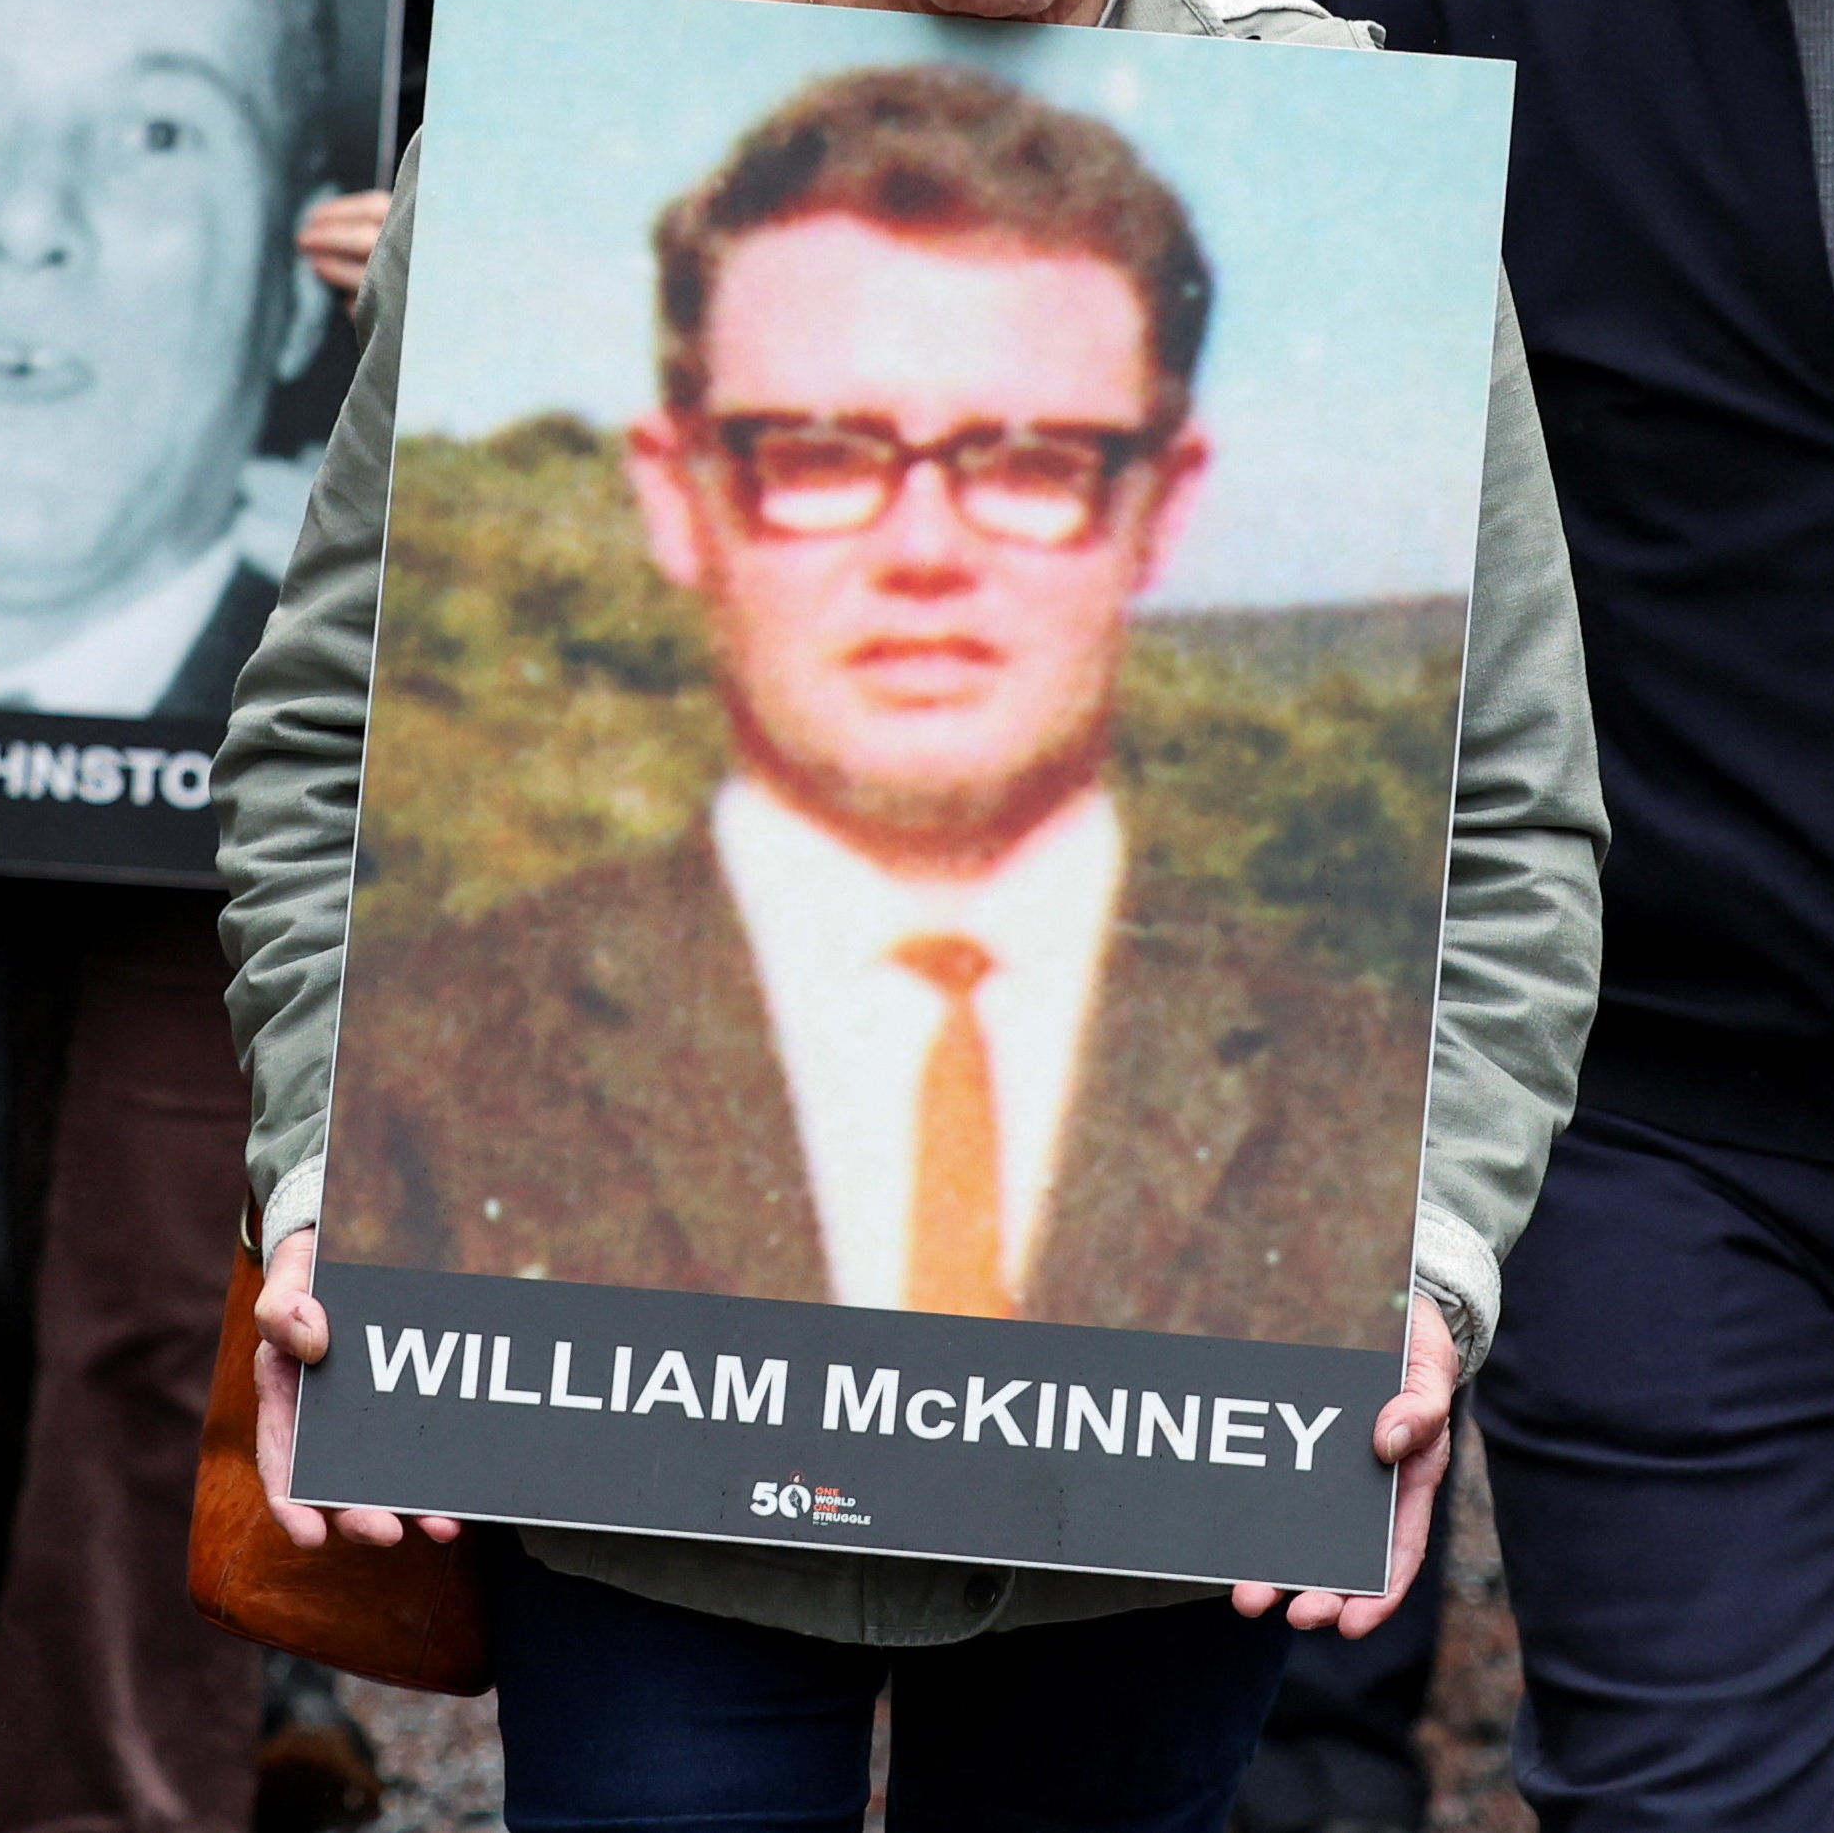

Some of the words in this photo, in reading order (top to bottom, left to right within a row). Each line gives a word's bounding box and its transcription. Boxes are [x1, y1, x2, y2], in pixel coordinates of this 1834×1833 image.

[365, 1324, 789, 1426] WILLIAM
[822, 1364, 1343, 1471] McKINNEY
[814, 1486, 840, 1497] ONE
[749, 1481, 811, 1519] 50
[814, 1494, 856, 1508] WORLD
[813, 1504, 839, 1514] ONE
[812, 1511, 872, 1526] STRUGGLE
